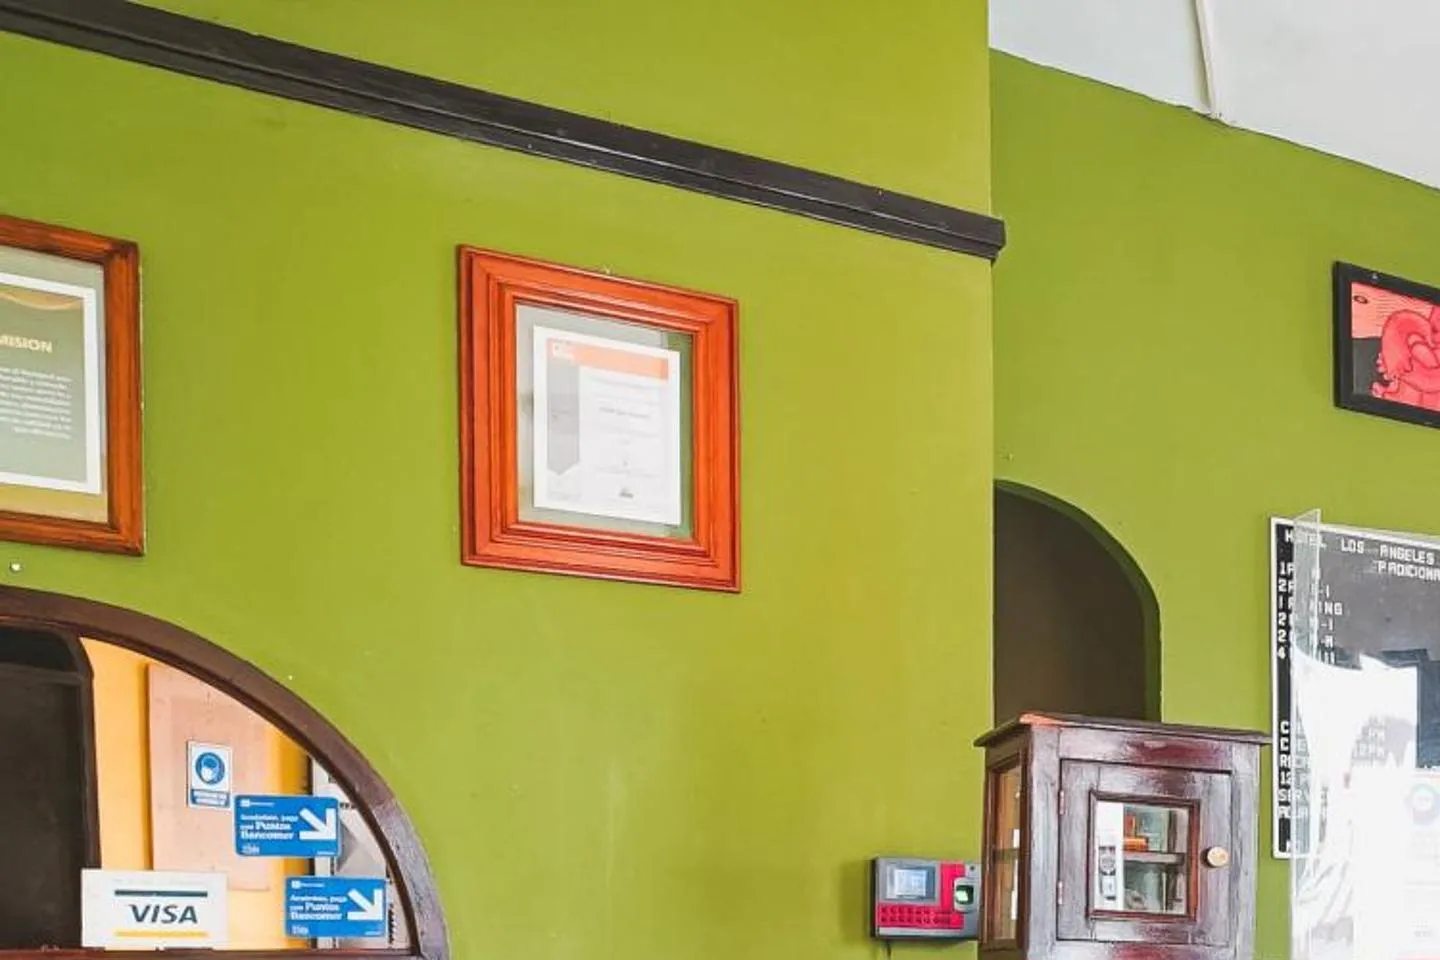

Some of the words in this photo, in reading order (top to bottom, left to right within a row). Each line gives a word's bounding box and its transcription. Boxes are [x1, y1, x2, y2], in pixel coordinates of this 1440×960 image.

[1284, 529, 1327, 549] HTEL
[1341, 537, 1365, 554] LOS
[1379, 543, 1435, 565] ANGELES
[128, 904, 198, 924] VISA
